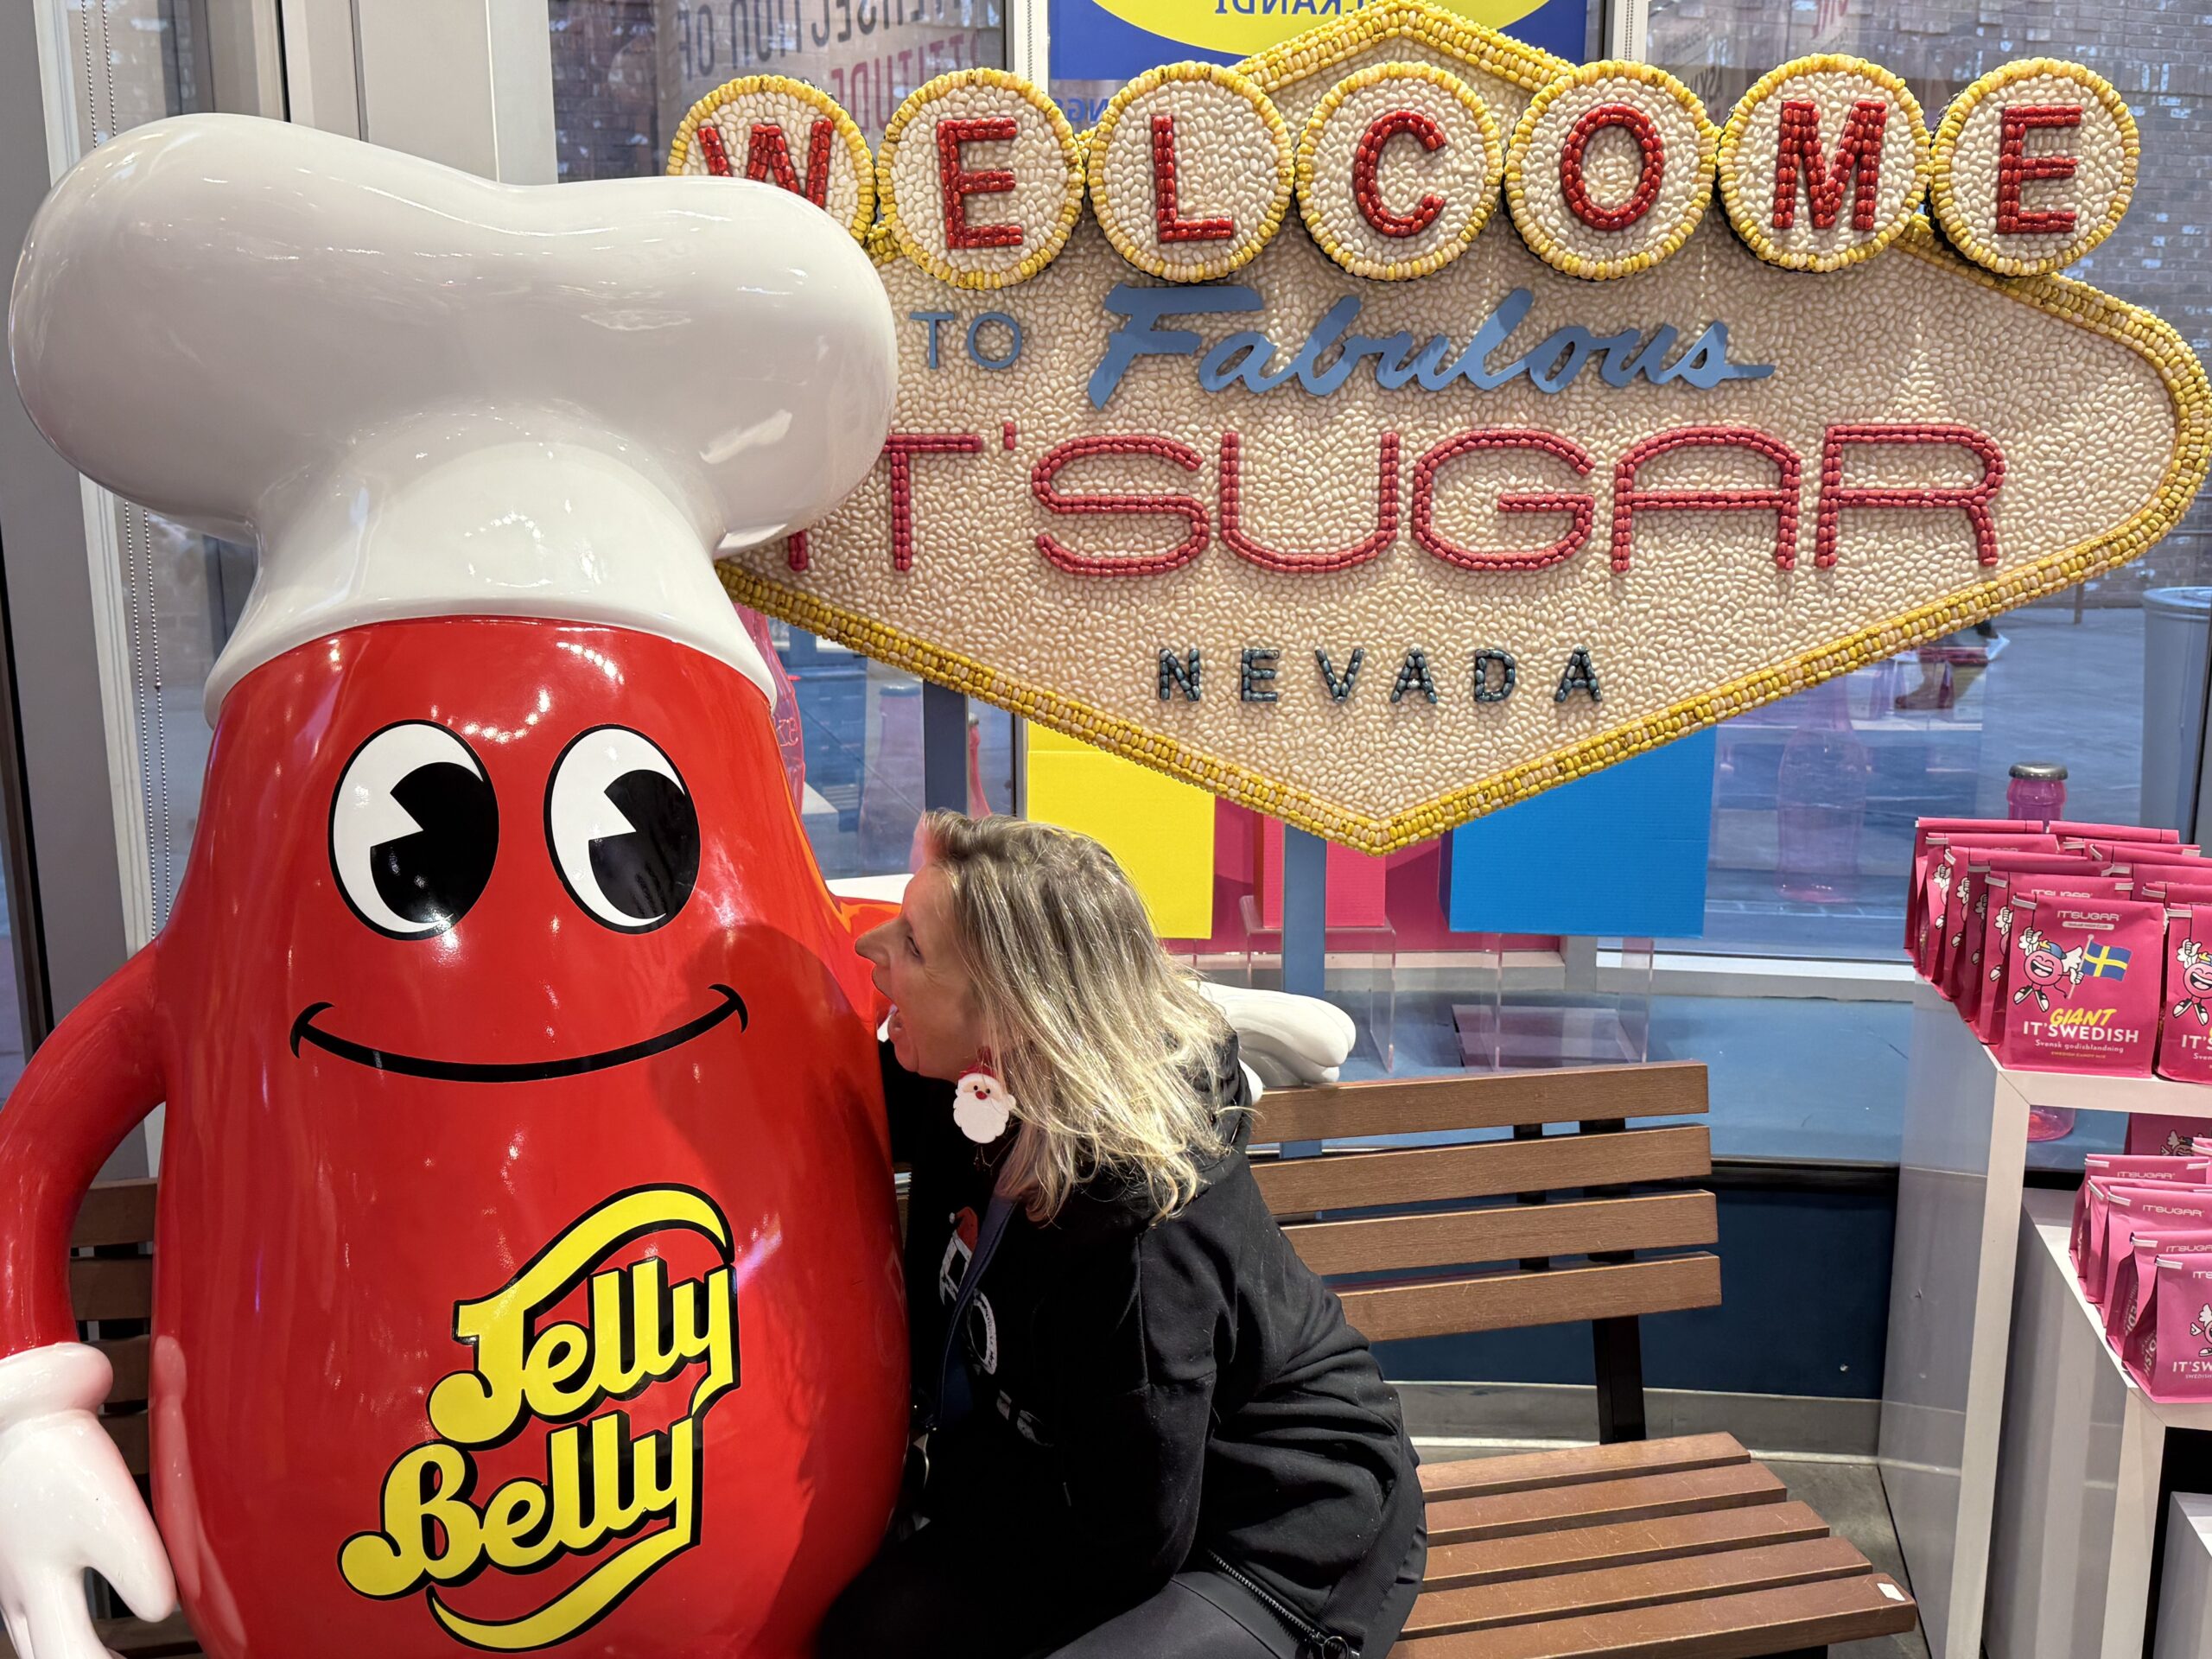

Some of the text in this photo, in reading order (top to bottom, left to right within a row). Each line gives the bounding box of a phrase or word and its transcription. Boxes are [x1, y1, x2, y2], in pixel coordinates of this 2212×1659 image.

[699, 99, 2083, 250] WELCOME
[909, 283, 1776, 409] TO Fabulous
[1159, 645, 1602, 704] NEVADA
[2023, 1020, 2139, 1044] IT'SWEDISH
[2035, 1039, 2124, 1053] Svensk godisblandning
[2050, 1007, 2118, 1027] GIANT
[426, 1182, 741, 1452] Jelly
[338, 1409, 704, 1652] Belly
